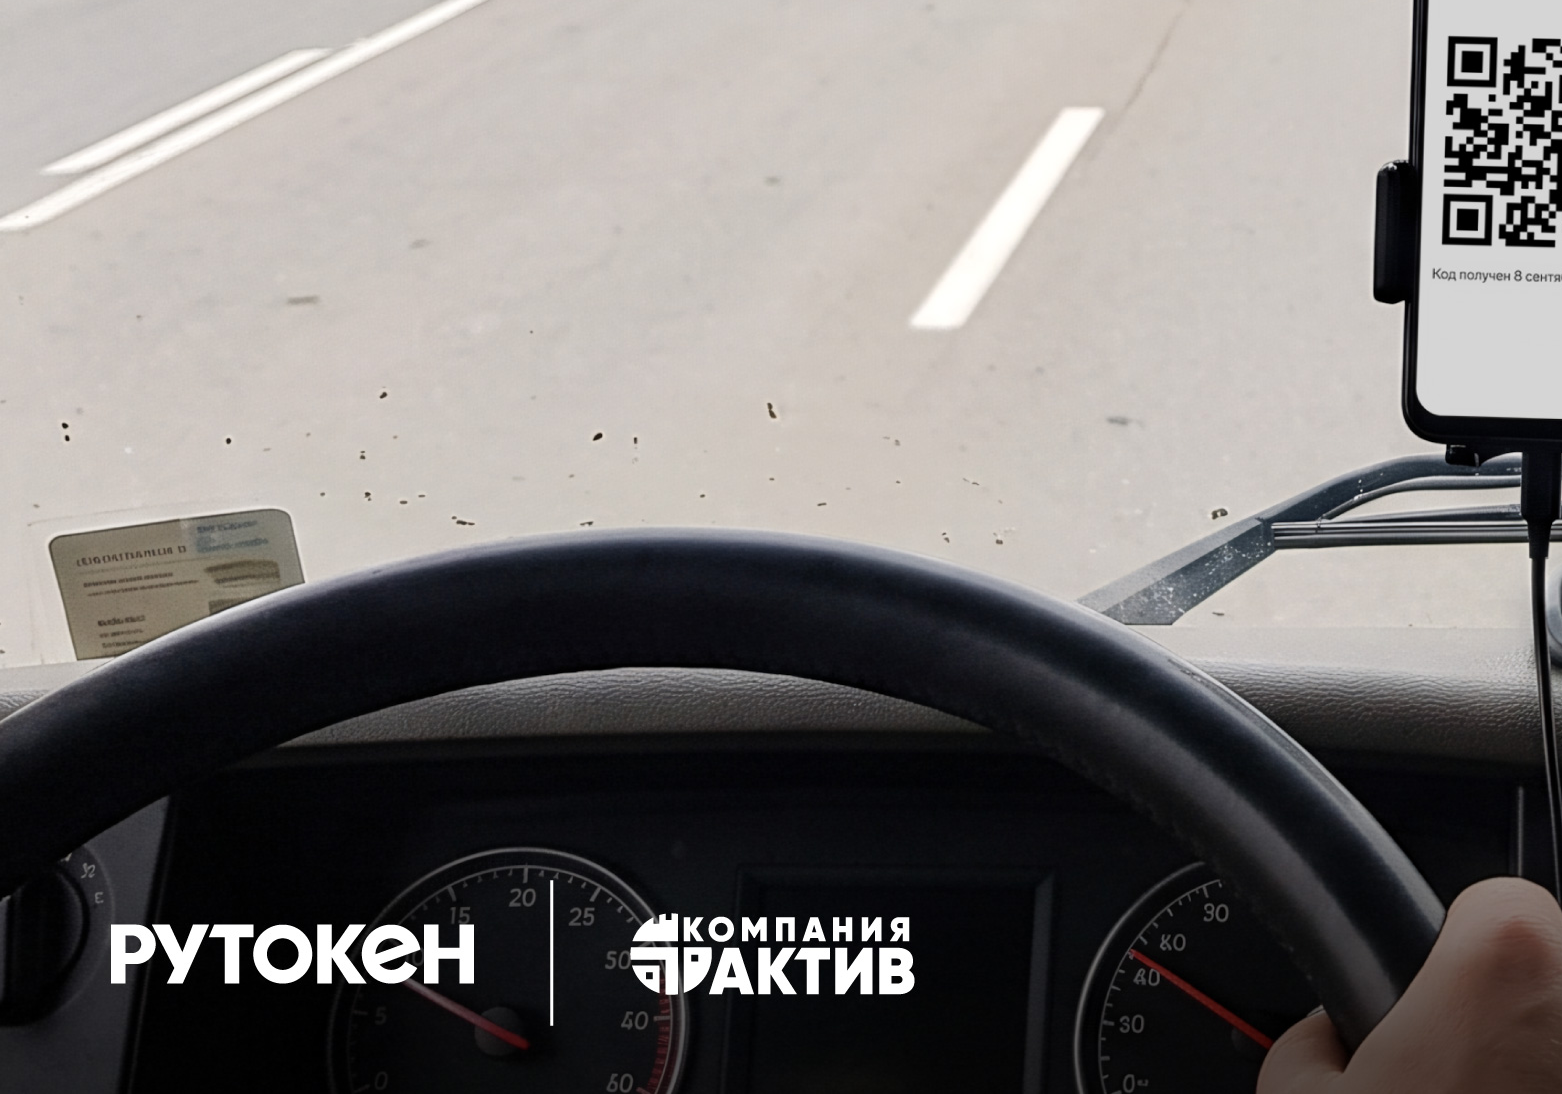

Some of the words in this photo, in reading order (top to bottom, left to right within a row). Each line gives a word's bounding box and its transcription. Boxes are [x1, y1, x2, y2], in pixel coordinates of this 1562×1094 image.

[1432, 268, 1457, 281] Код
[1459, 272, 1511, 283] получен
[1513, 270, 1522, 281] 8
[508, 888, 537, 907] 20
[450, 907, 471, 925] 15
[568, 907, 595, 926] 25
[604, 950, 631, 970] 50
[375, 1006, 387, 1025] 5
